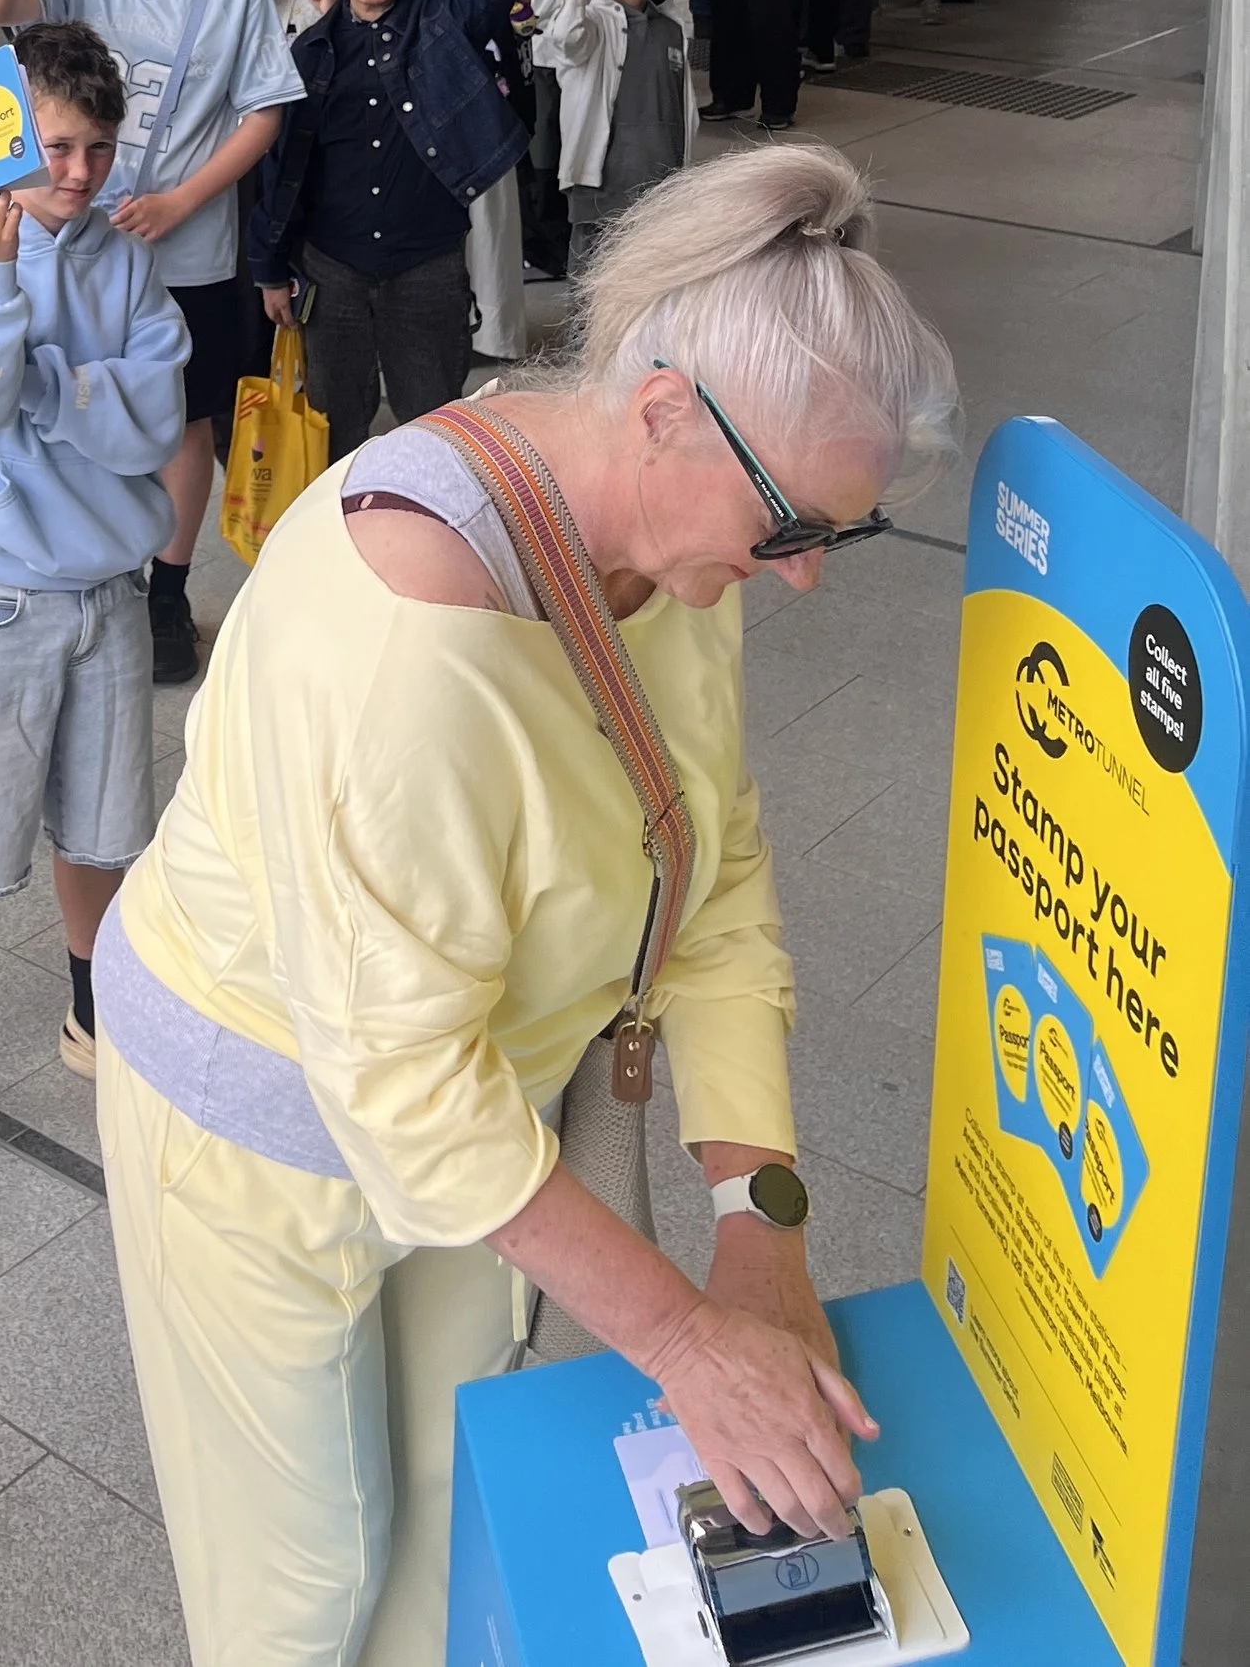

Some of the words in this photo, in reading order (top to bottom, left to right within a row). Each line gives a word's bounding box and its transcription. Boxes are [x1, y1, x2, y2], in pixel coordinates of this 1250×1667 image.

[995, 508, 1049, 576] SERIES
[997, 480, 1051, 545] SUMMER
[1145, 633, 1188, 687] Collect
[1145, 666, 1160, 690] all
[1161, 676, 1183, 710] five
[1140, 690, 1185, 742] stamps!
[1046, 687, 1151, 817] METROTUNNEL
[993, 742, 1085, 888] Stamp
[1090, 866, 1167, 979] your
[973, 794, 1100, 980] passport
[1105, 946, 1180, 1079] here
[1039, 1039, 1076, 1103] Passport
[1061, 1284, 1084, 1331] Town
[1101, 1349, 1128, 1404] Anzac
[1088, 1304, 1121, 1367] stations
[1084, 1372, 1129, 1459] Melbourne
